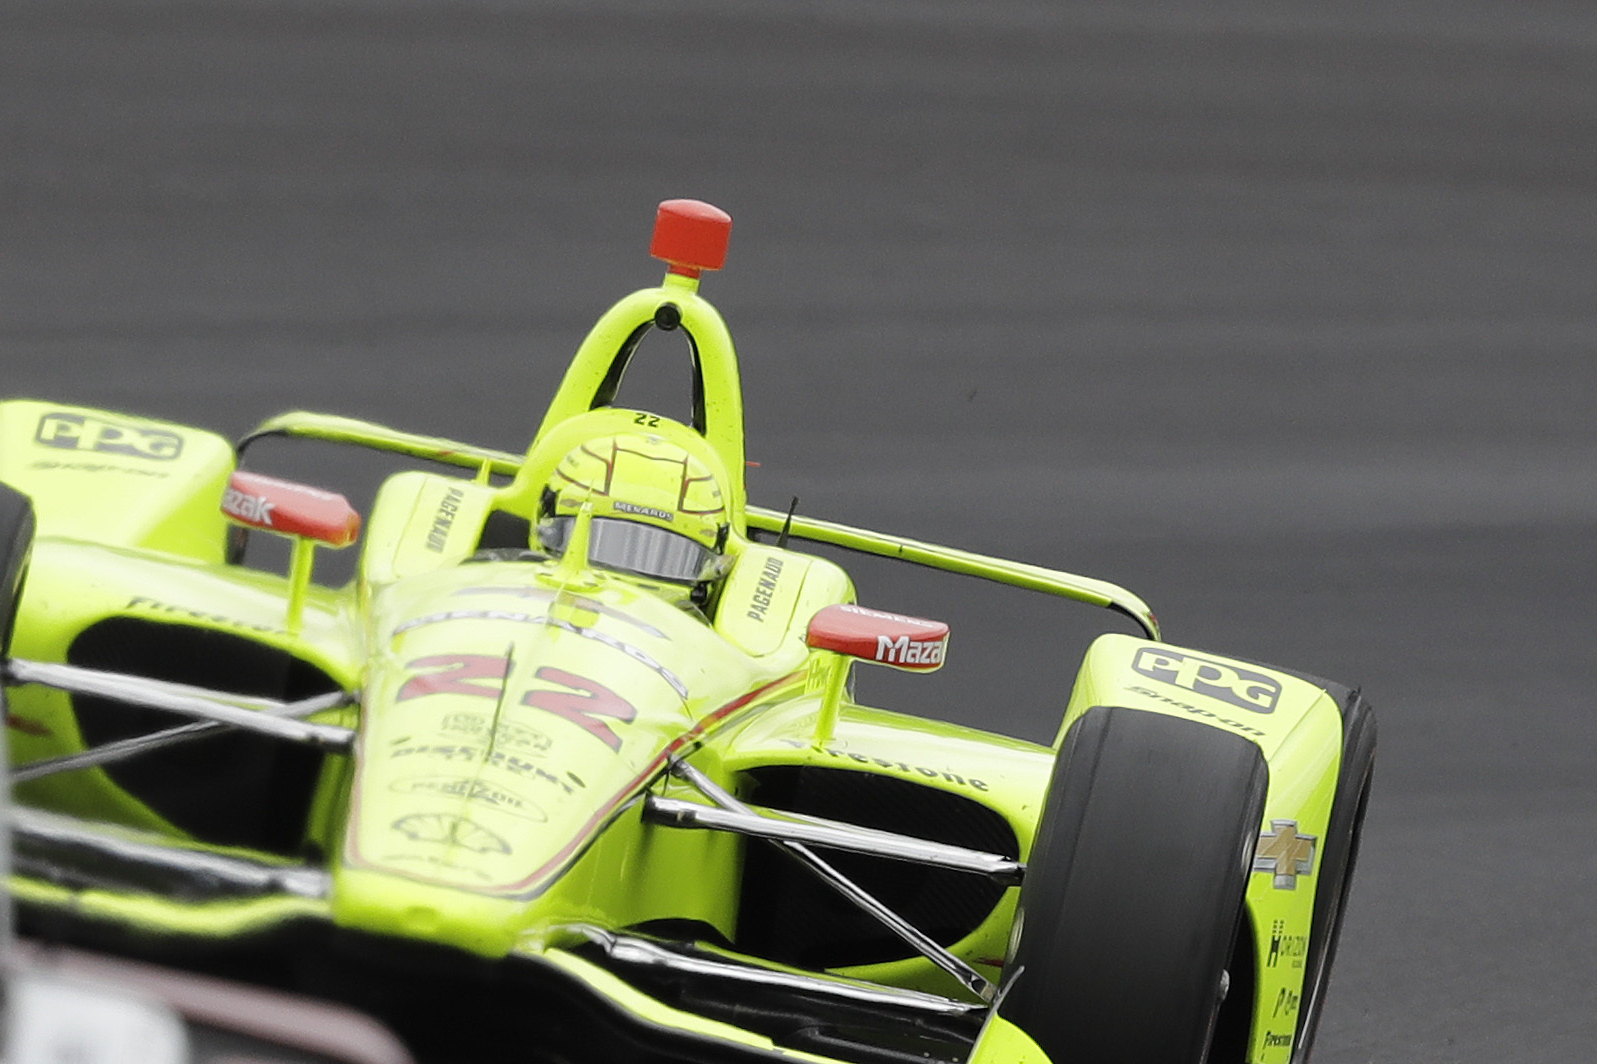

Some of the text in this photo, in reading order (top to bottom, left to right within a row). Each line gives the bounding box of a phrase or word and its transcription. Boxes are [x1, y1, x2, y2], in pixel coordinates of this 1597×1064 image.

[38, 416, 182, 459] PPG
[633, 412, 662, 428] 22
[746, 556, 784, 623] PAGENAUD
[395, 653, 638, 755] 22
[1136, 651, 1278, 709] PPG
